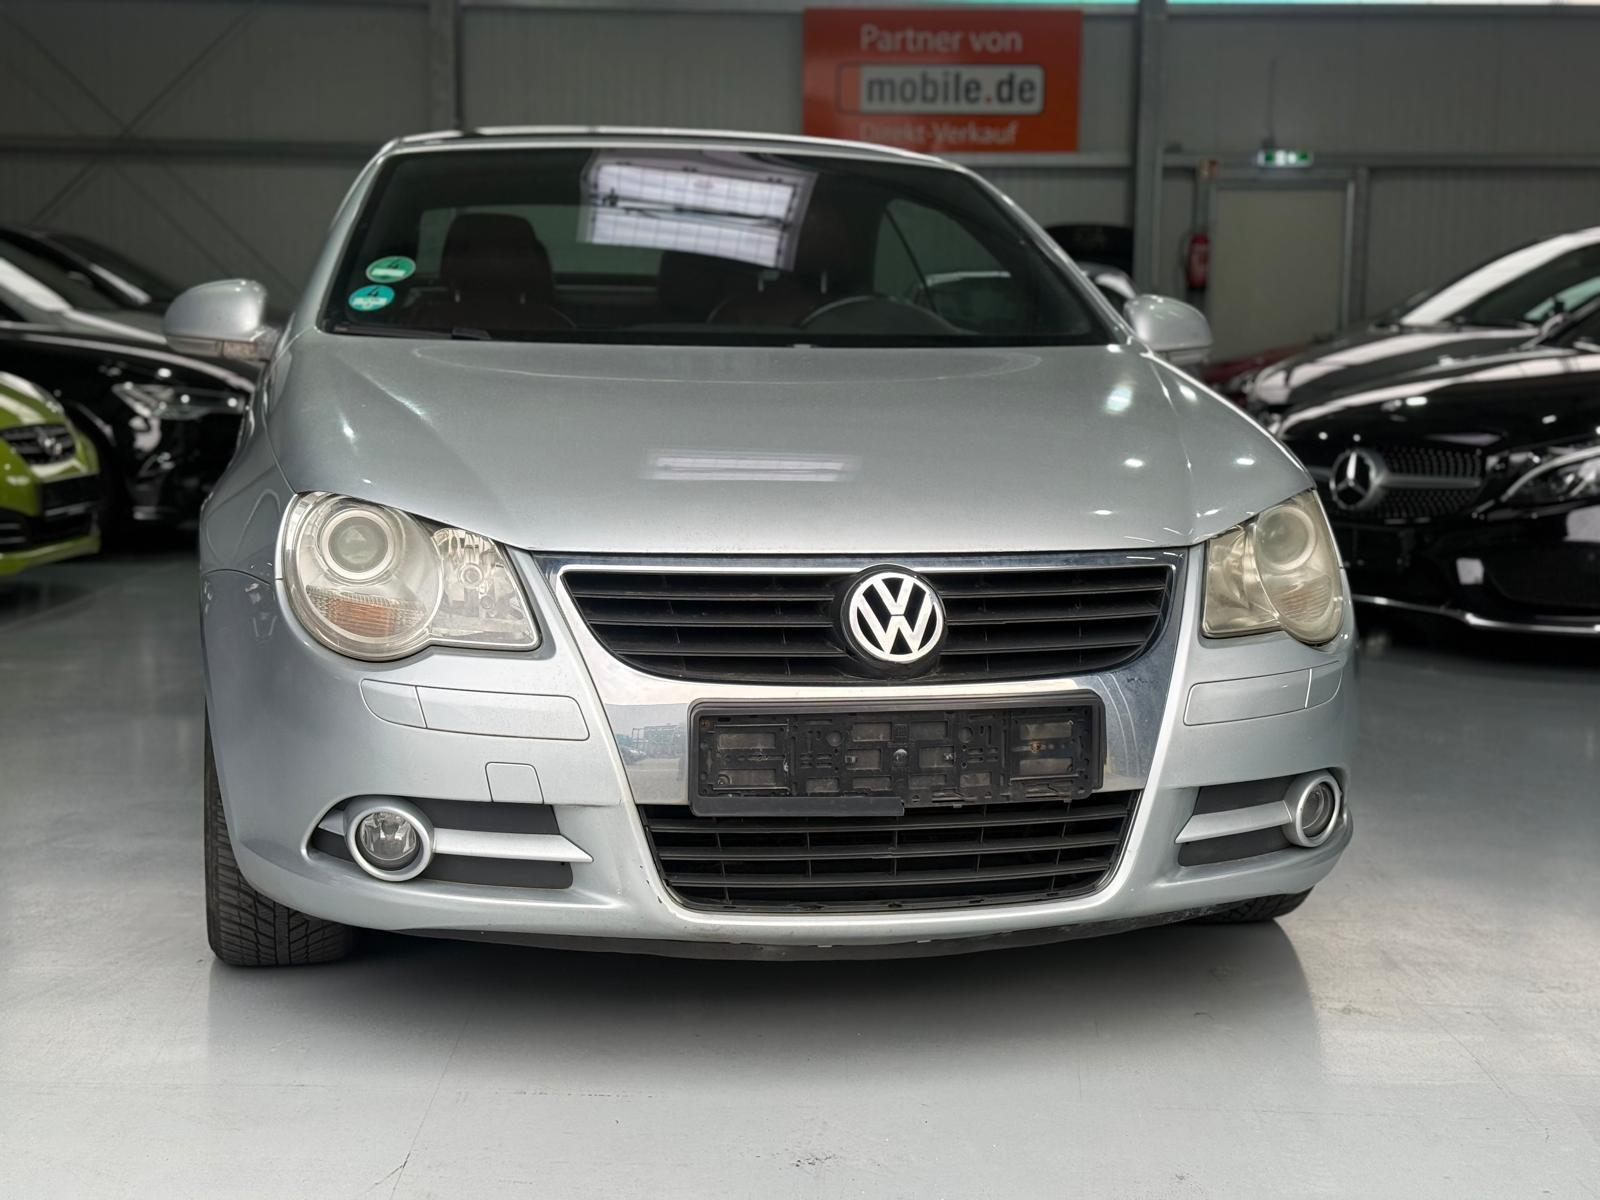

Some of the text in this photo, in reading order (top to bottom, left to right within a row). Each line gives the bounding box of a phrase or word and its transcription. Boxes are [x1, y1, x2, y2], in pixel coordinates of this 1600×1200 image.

[859, 24, 1023, 53] Partner von
[866, 71, 1037, 104] mobile.de
[849, 572, 943, 662] VW
